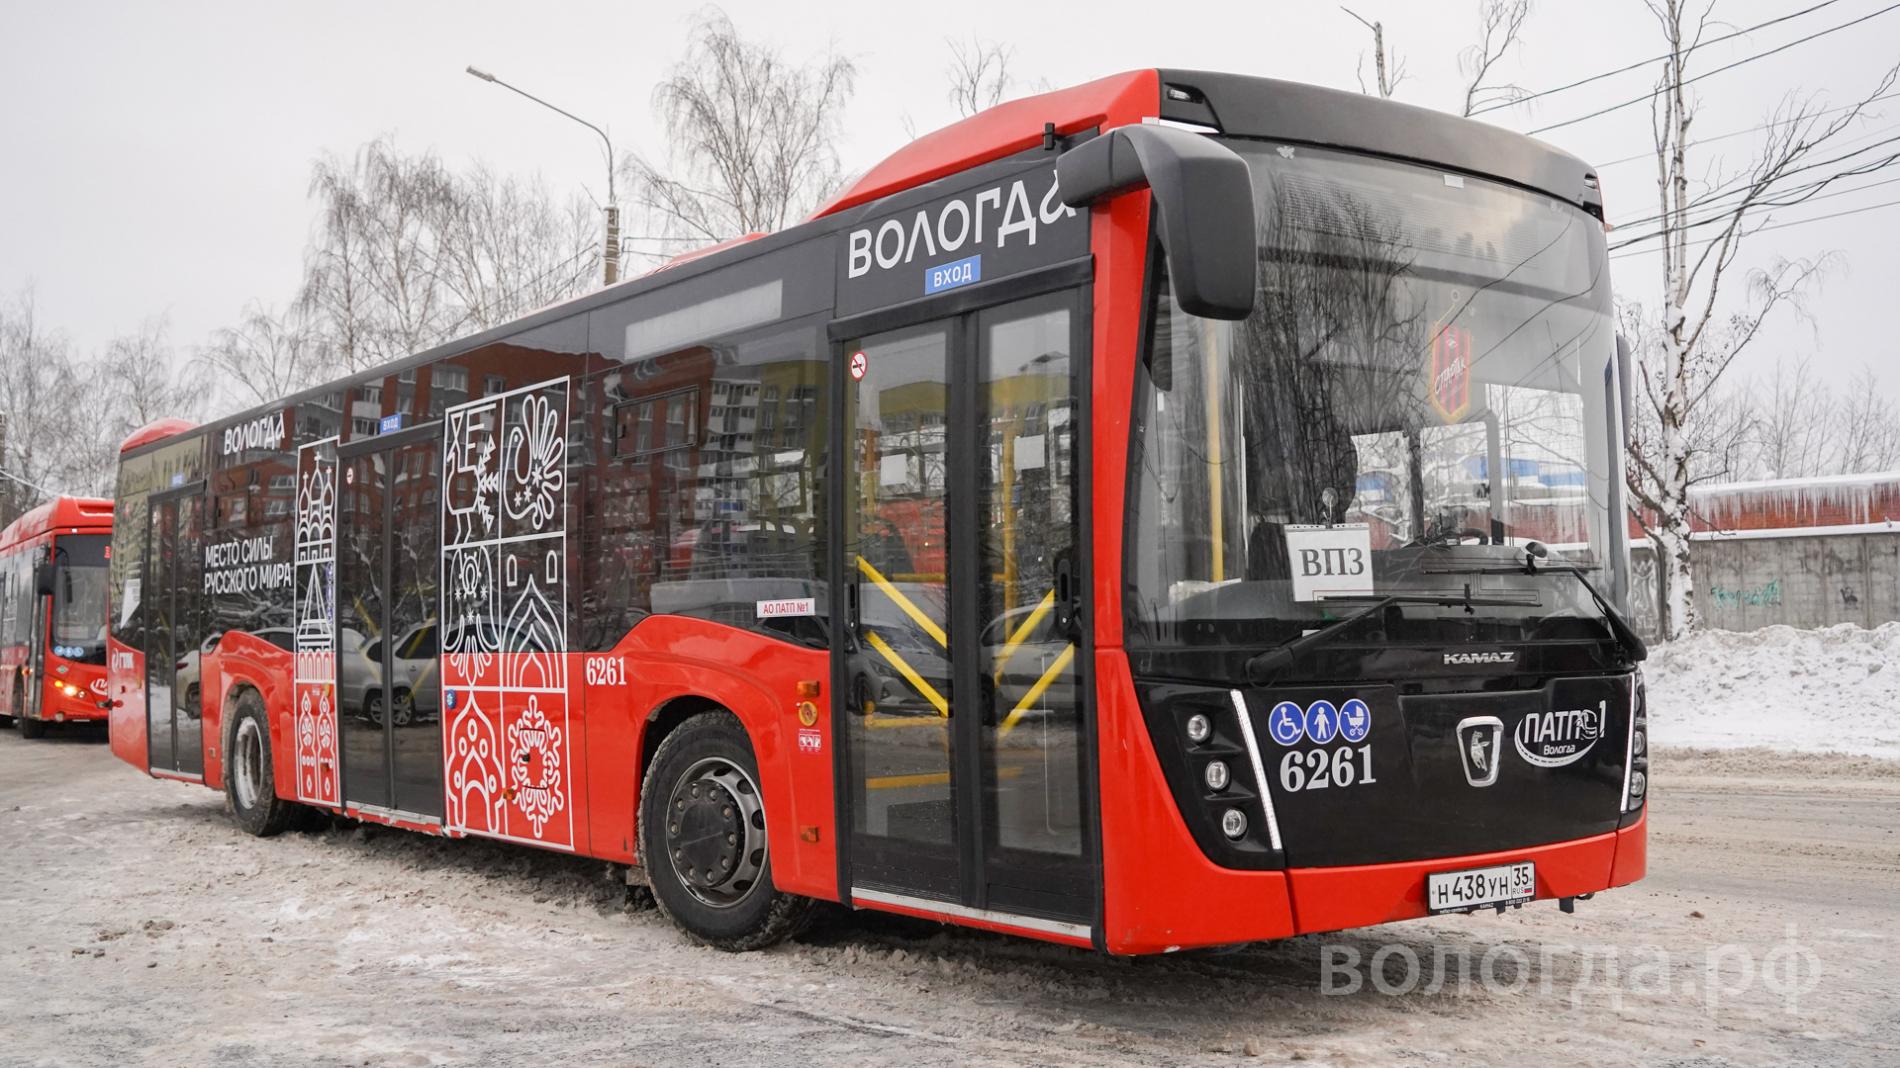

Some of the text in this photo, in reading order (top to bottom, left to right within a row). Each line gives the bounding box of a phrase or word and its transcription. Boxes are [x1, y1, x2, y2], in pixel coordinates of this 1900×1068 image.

[933, 262, 972, 288] ВХОД
[205, 536, 273, 568] МЕСТО СИЛЫ
[1298, 547, 1365, 577] ВПЗ
[204, 562, 292, 595] РУССКОГО МИРА
[763, 604, 774, 615] АО
[776, 602, 796, 614] ПАТП
[586, 656, 627, 686] 6261
[1443, 652, 1515, 665] KAMAZ
[1543, 744, 1576, 756] Вологда
[1279, 743, 1377, 793] 6261
[1513, 866, 1529, 887] 35
[1512, 886, 1524, 895] RUS
